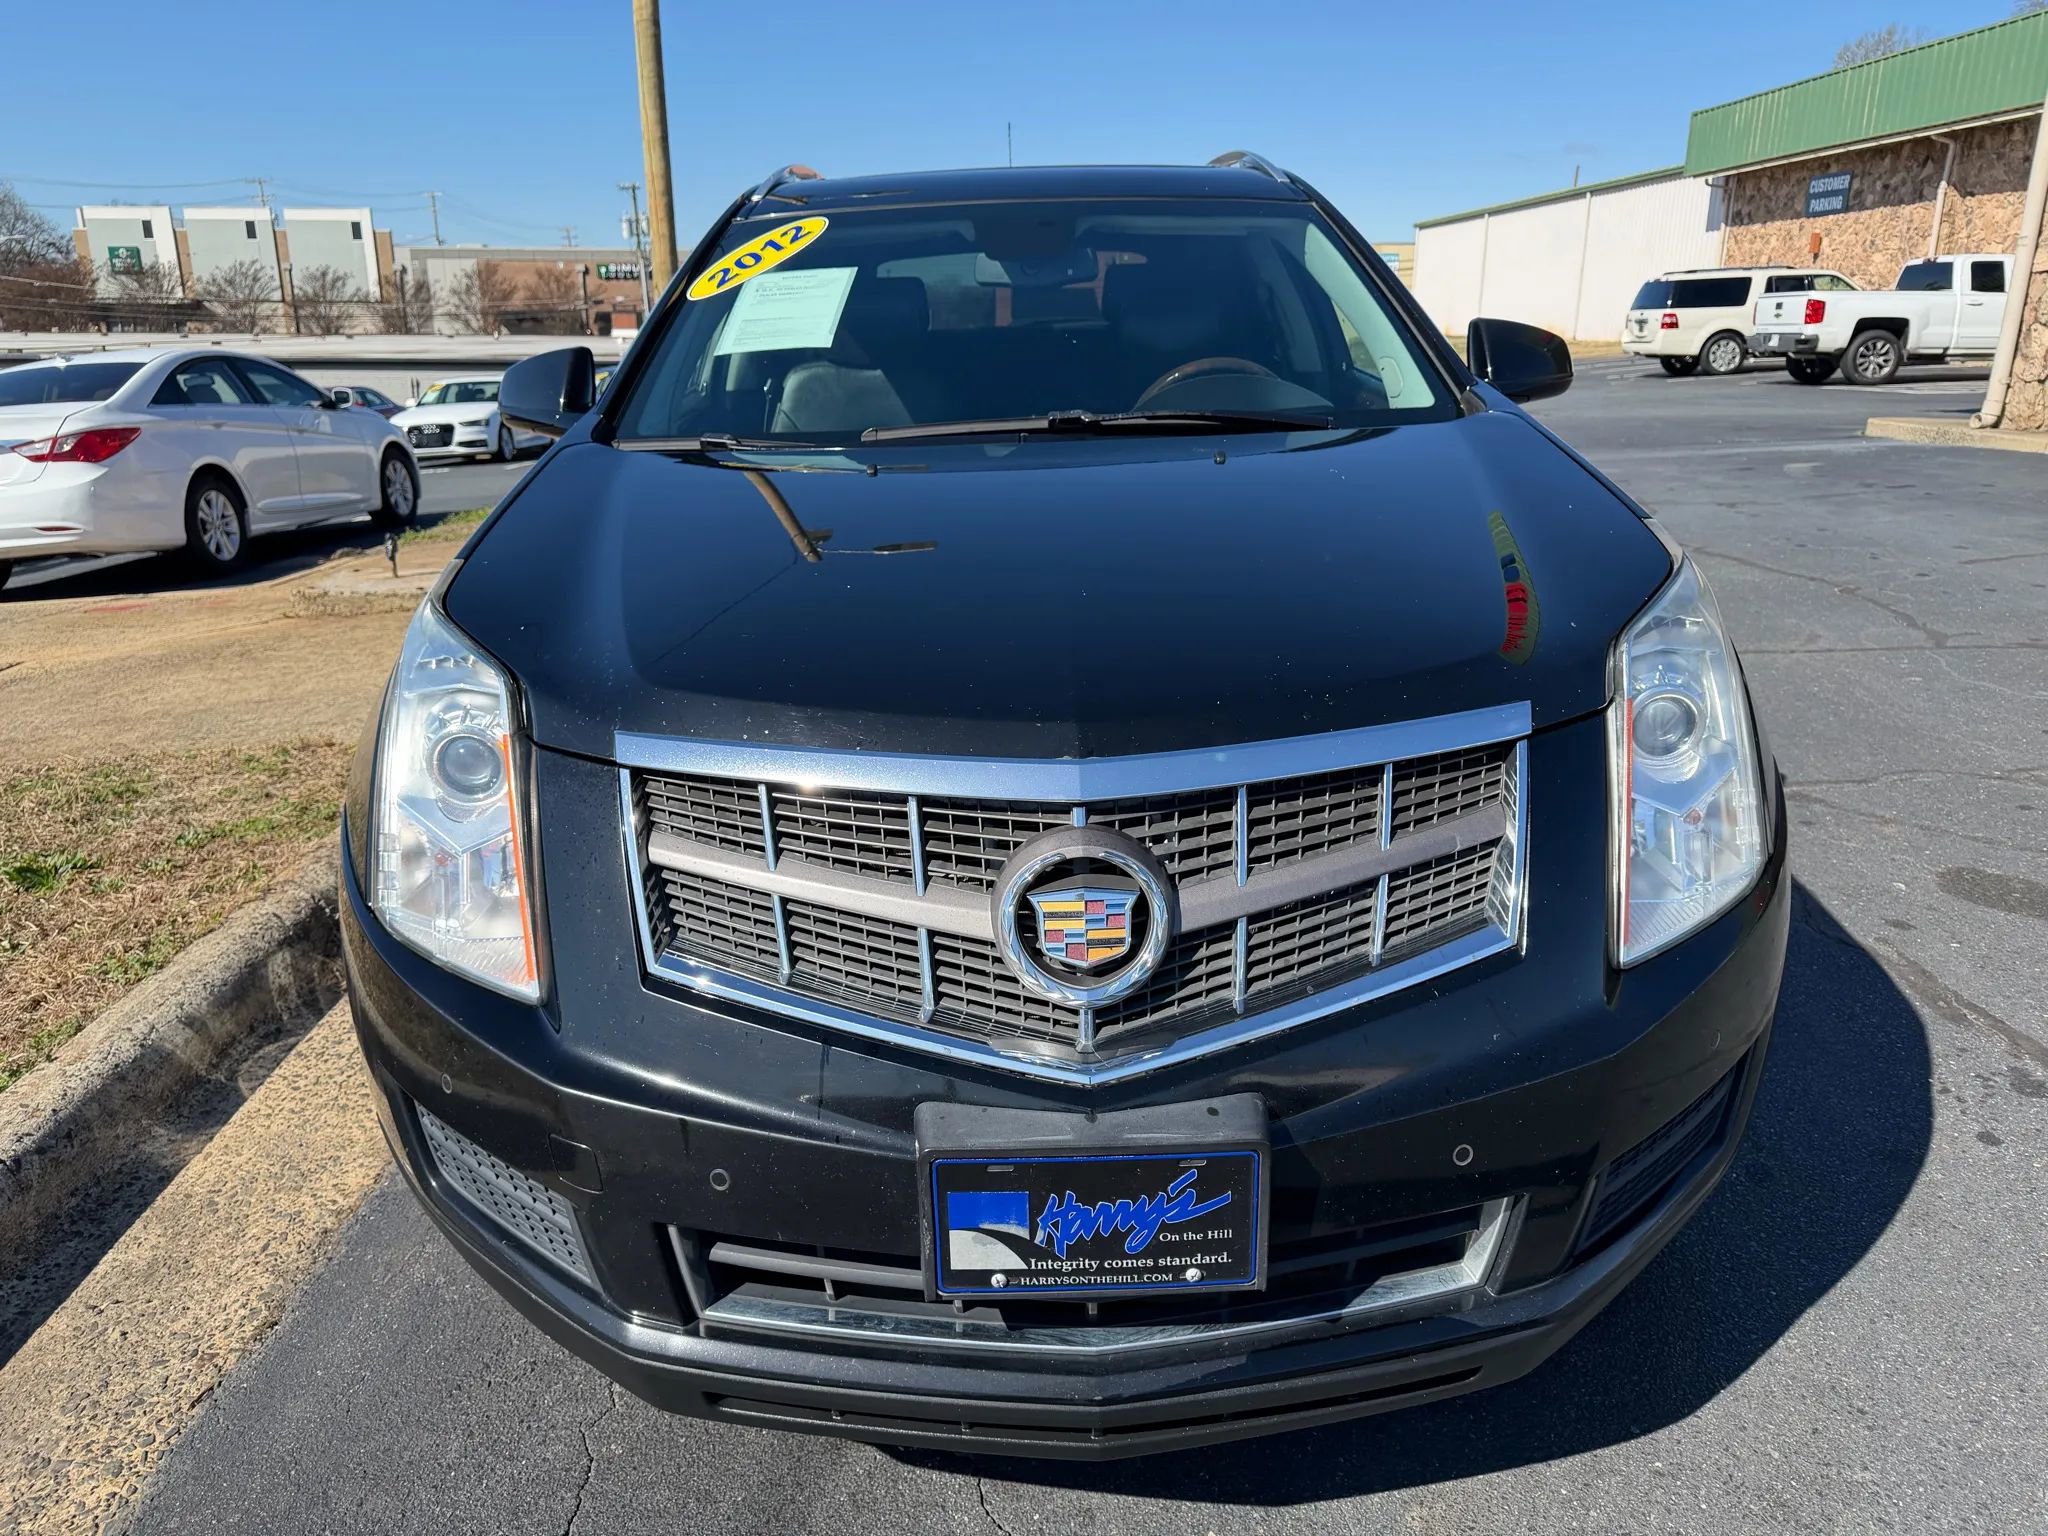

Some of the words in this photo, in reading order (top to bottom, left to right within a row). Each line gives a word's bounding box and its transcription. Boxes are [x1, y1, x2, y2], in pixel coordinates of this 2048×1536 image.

[1809, 174, 1851, 193] CUSTOMER
[1809, 196, 1843, 212] PARKING
[707, 225, 813, 289] 2012
[1034, 1168, 1232, 1260] Harry's
[1159, 1232, 1180, 1242] On
[1183, 1230, 1204, 1241] the
[1207, 1229, 1233, 1239] Hill
[1029, 1257, 1100, 1273] Integrity
[1104, 1257, 1154, 1269] comes
[1158, 1252, 1233, 1267] standard.
[1020, 1273, 1173, 1286] HARRYSONTHEHILL.COM
